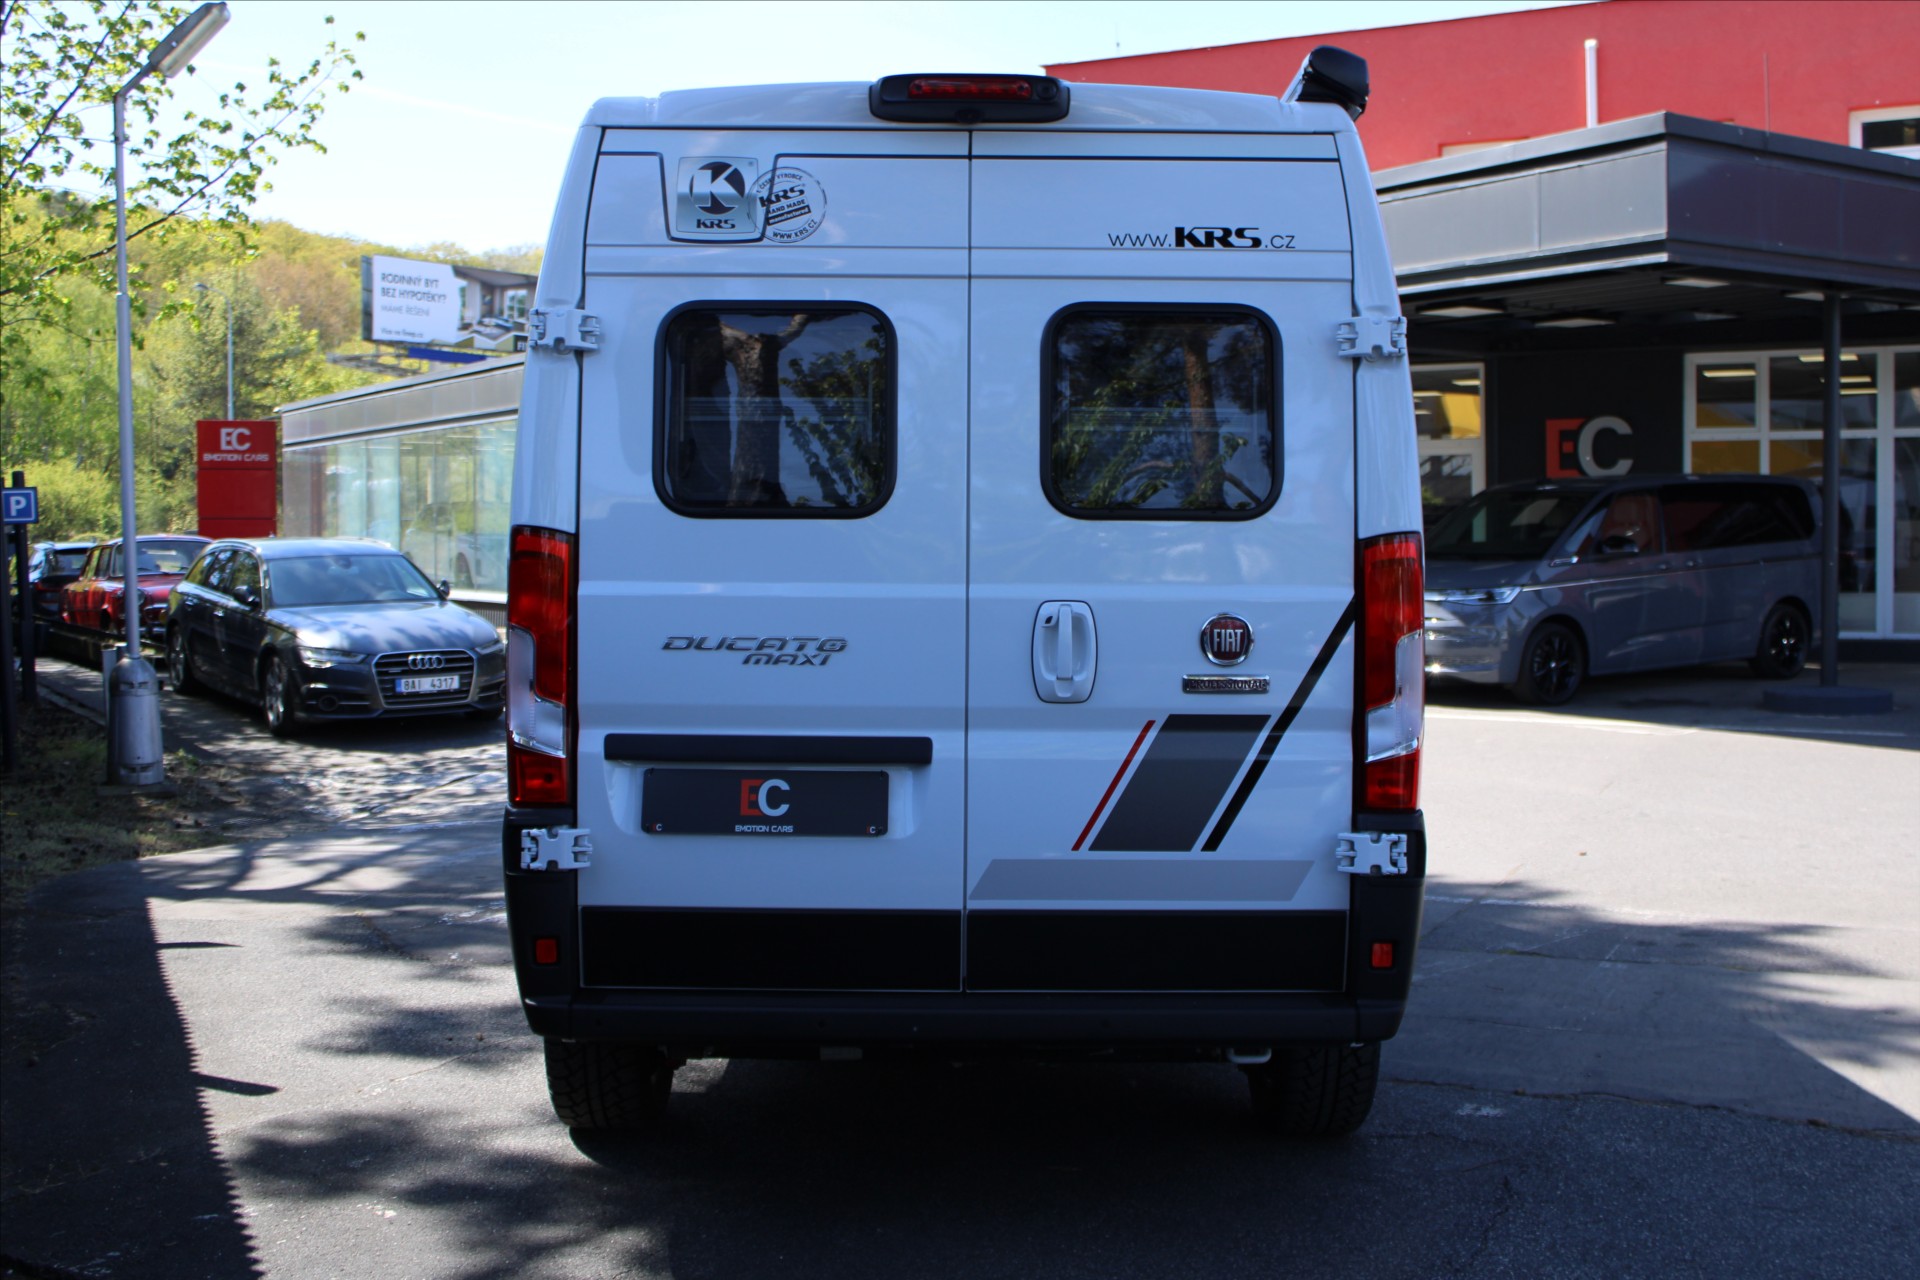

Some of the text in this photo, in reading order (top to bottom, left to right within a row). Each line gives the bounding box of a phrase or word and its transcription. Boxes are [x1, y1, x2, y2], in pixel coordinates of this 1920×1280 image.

[758, 183, 805, 208] KRS
[786, 199, 806, 209] MADE
[696, 218, 736, 229] KRS
[772, 218, 818, 239] WWW.KRS.CZ
[1108, 226, 1296, 249] www.KRS.cz
[381, 273, 440, 289] RODINNÝ BYT
[381, 287, 447, 304] BEZ HYPOTÉKY?
[220, 427, 251, 451] EC
[1545, 416, 1634, 479] EC
[203, 453, 269, 461] EMOTION CARS
[10, 496, 27, 517] P
[662, 636, 848, 652] DUCATO
[1213, 629, 1243, 652] FIAT
[742, 653, 832, 666] MAXI
[430, 678, 455, 689] 4317
[740, 779, 790, 816] EC
[771, 825, 794, 833] CARS
